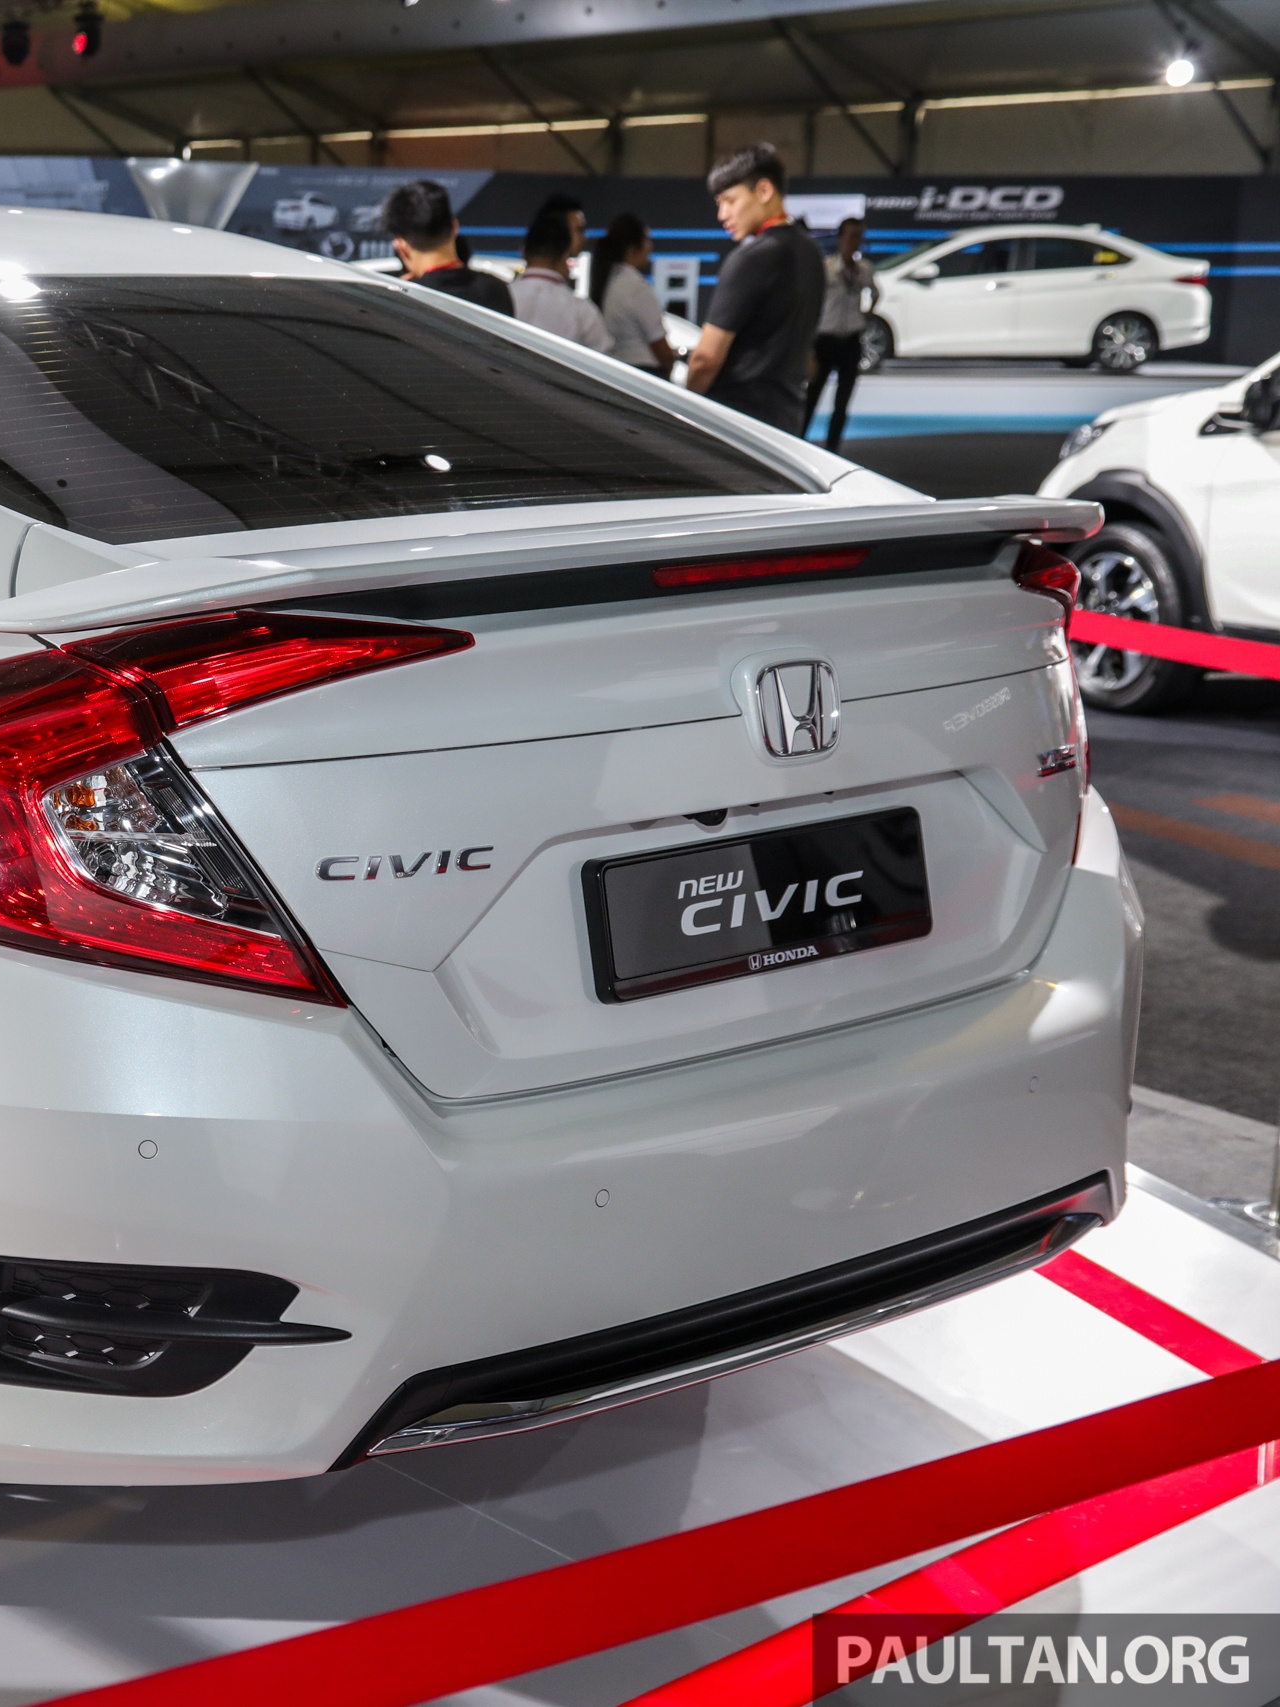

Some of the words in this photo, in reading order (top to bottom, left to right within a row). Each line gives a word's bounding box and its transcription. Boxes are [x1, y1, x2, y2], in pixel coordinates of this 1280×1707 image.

[315, 845, 494, 881] CIVIC
[681, 870, 864, 936] CIVIC
[763, 945, 819, 966] HONDA
